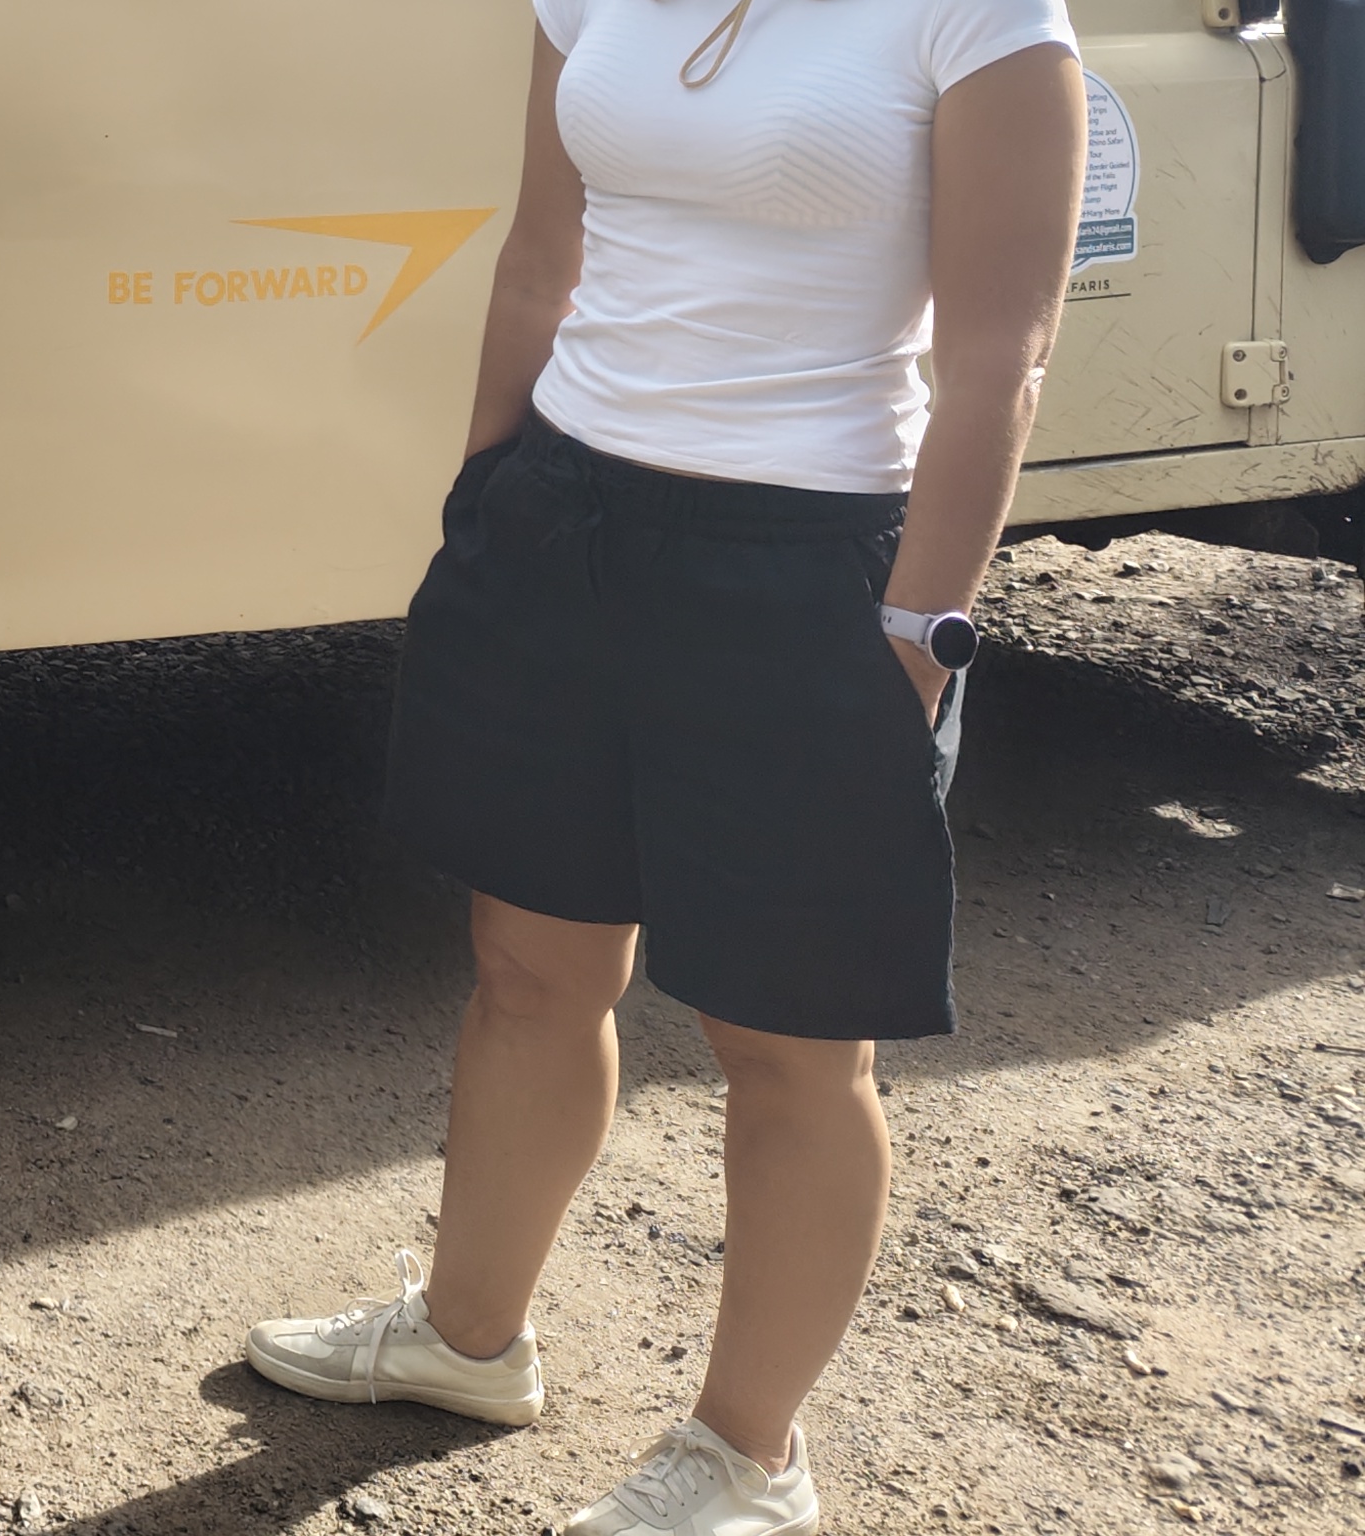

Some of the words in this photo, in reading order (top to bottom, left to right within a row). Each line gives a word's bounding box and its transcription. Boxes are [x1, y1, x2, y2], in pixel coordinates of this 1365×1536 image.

[1105, 127, 1117, 136] and
[1106, 136, 1124, 145] Safari
[108, 272, 153, 305] BE
[173, 264, 368, 306] FORWARD
[1067, 279, 1110, 293] FARIS
